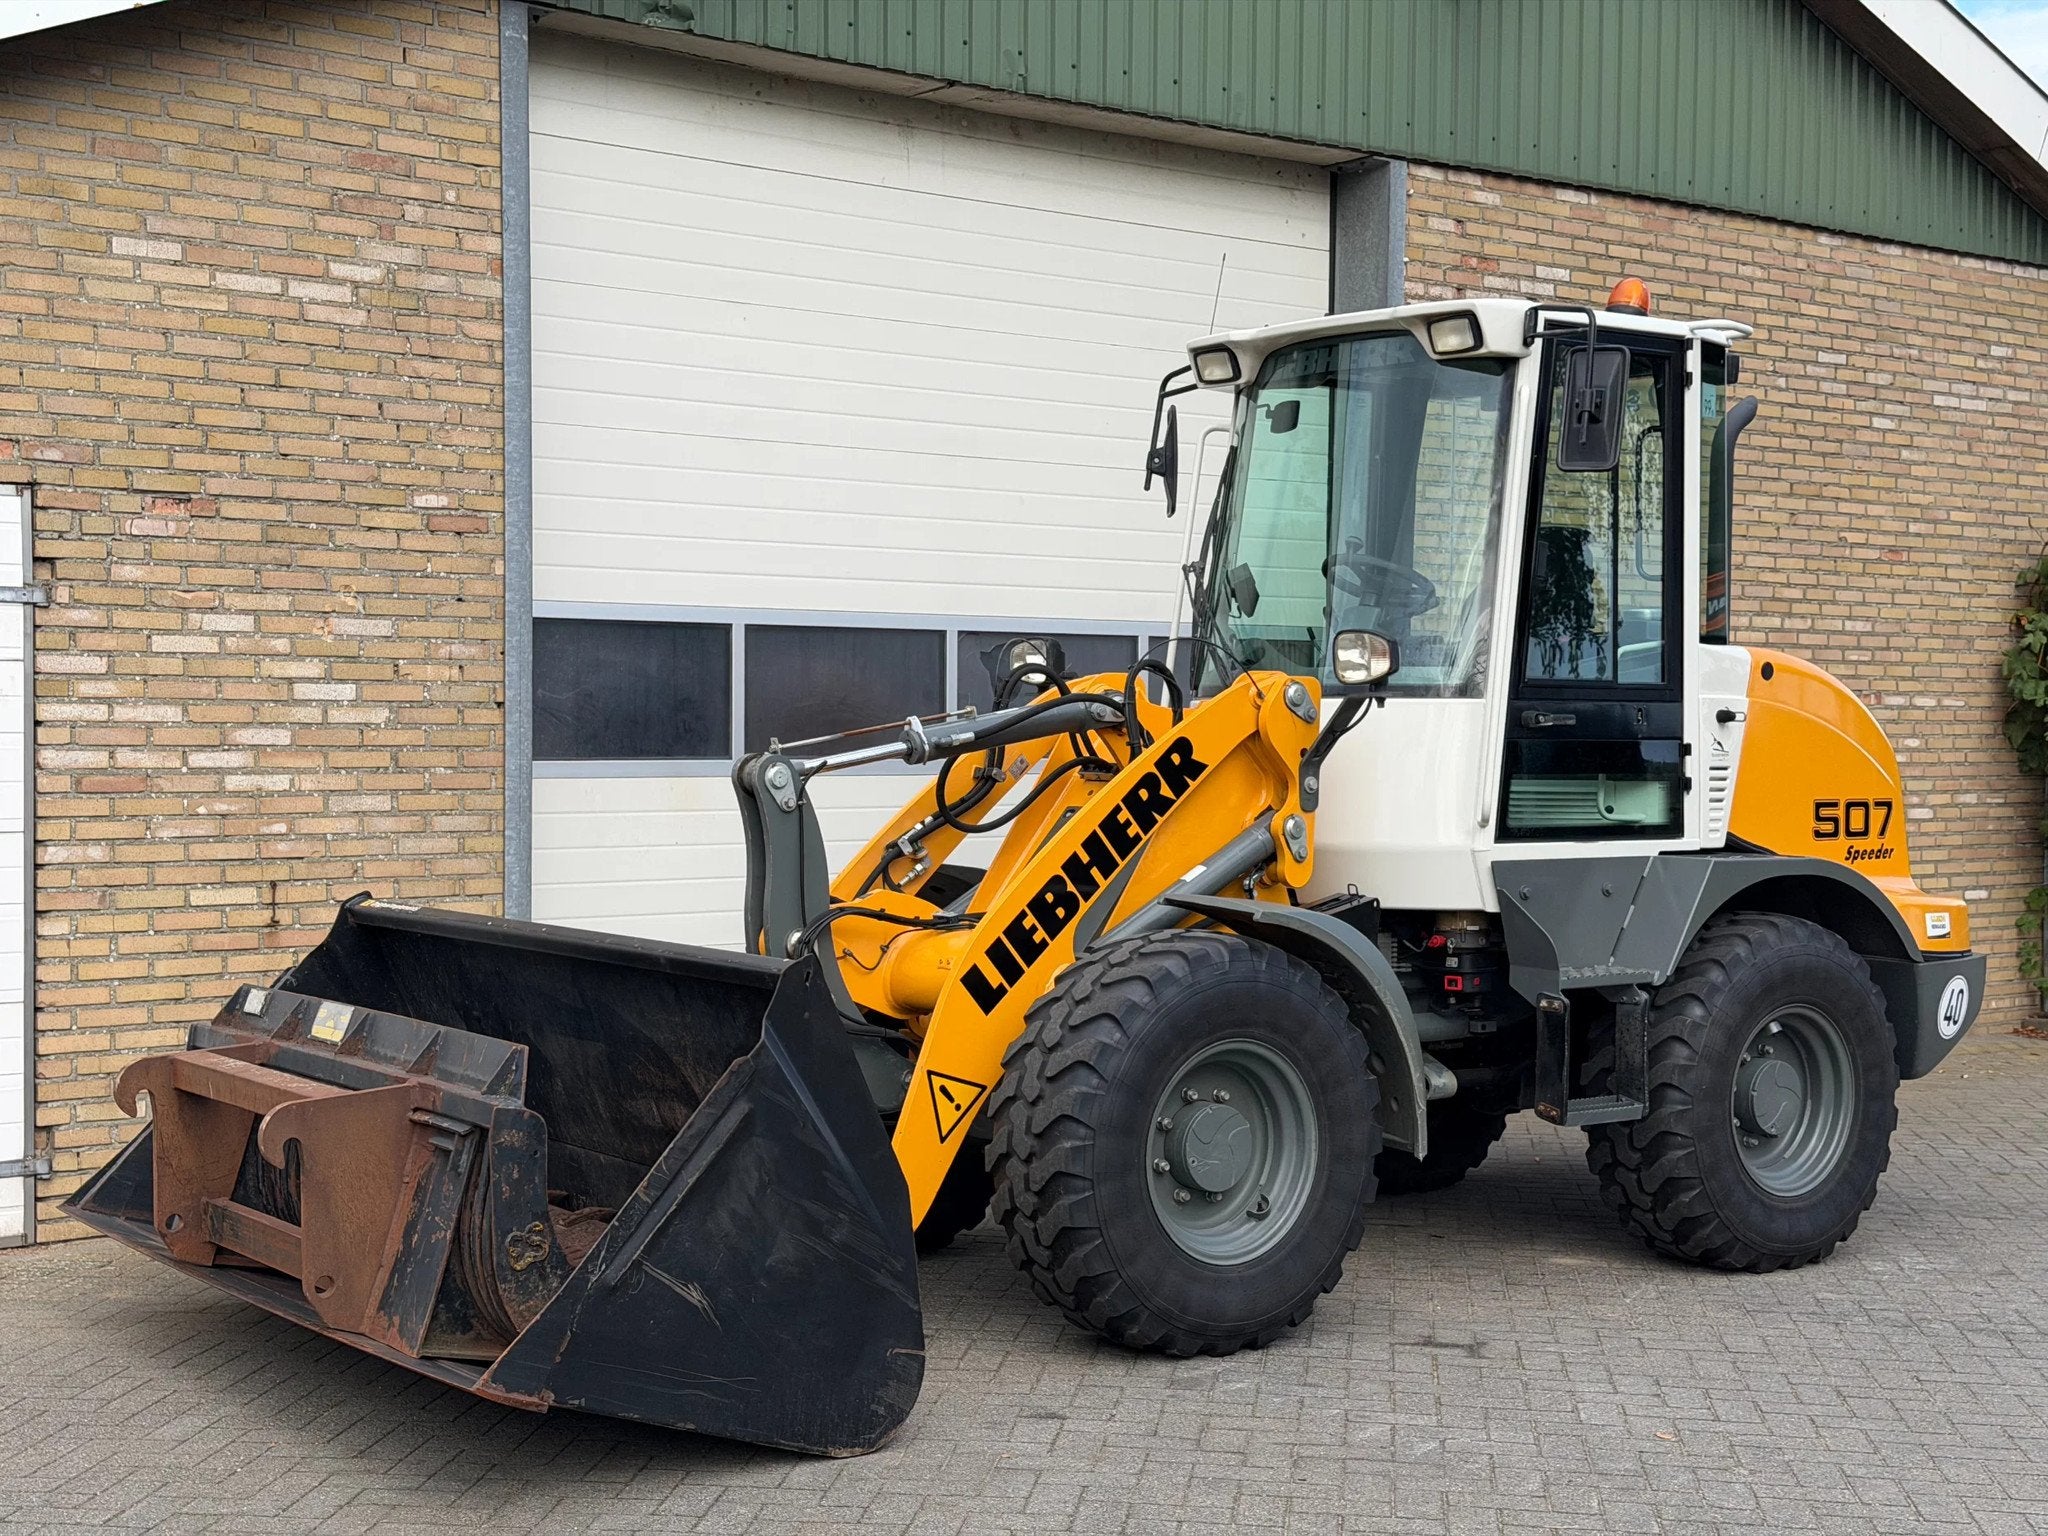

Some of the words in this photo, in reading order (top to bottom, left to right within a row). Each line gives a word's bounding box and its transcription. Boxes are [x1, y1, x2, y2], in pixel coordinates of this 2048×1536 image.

[1267, 337, 1415, 380] BHERR
[1812, 798, 1893, 841] 507
[1844, 843, 1895, 864] Speeder
[959, 736, 1209, 1016] LIEBHERR
[1943, 988, 1964, 1026] 40
